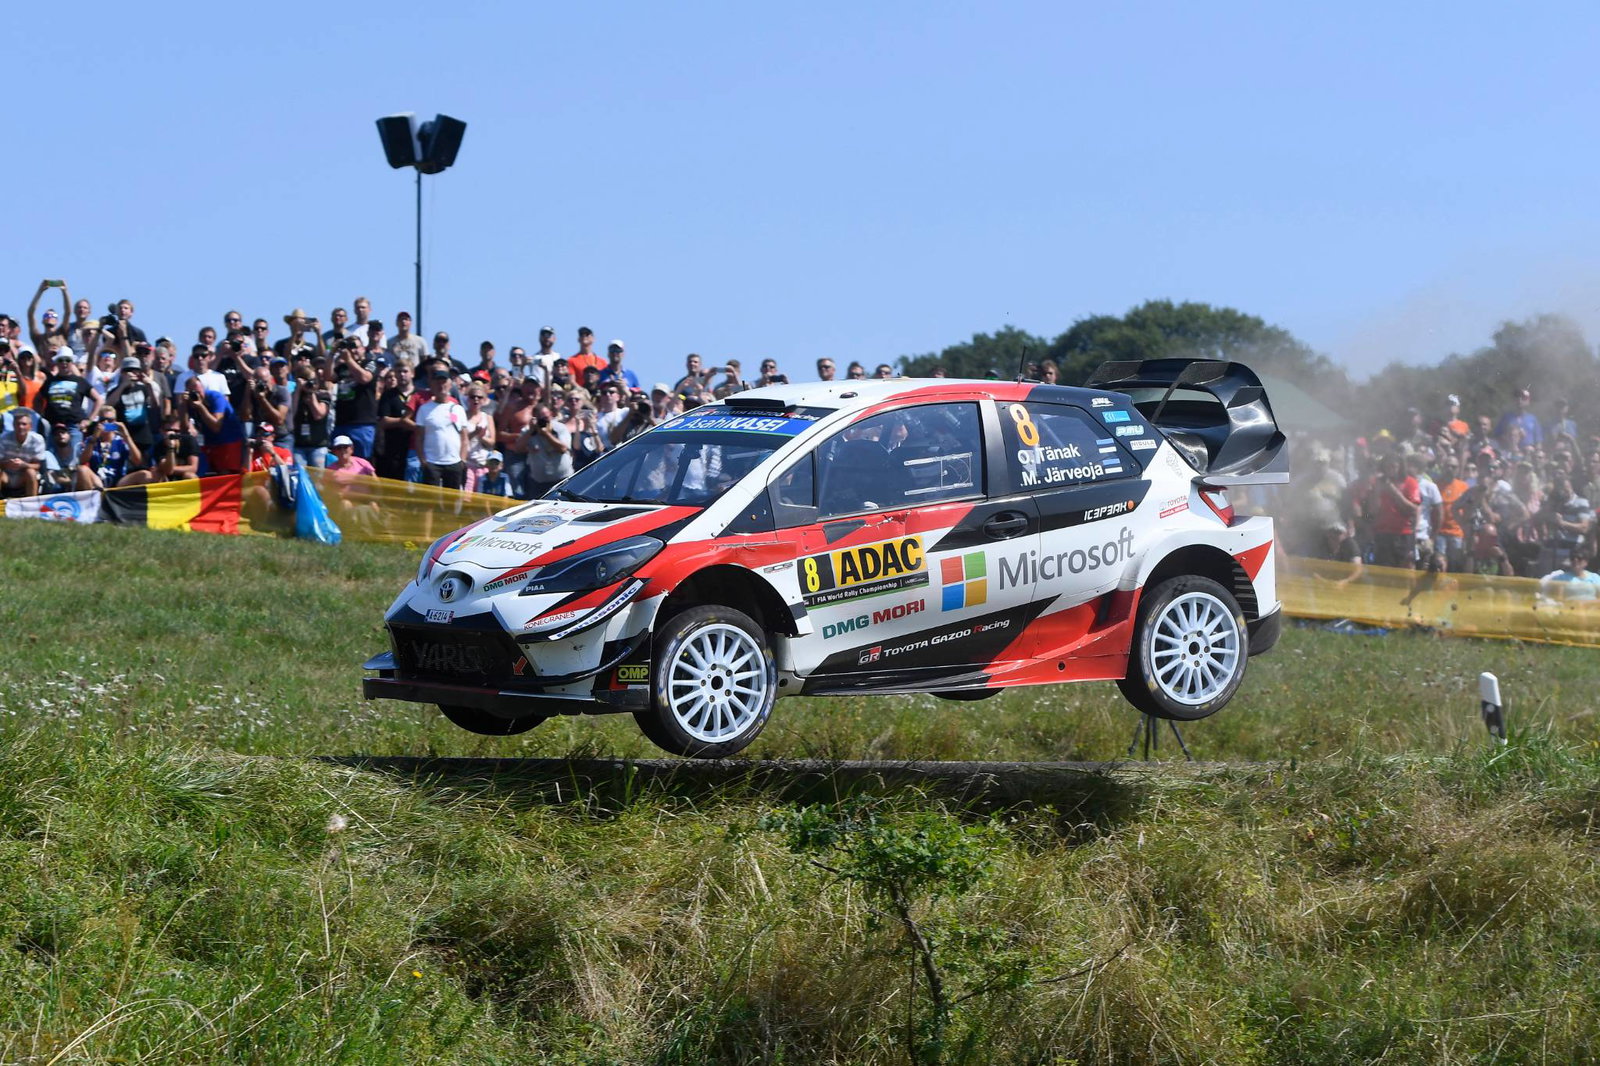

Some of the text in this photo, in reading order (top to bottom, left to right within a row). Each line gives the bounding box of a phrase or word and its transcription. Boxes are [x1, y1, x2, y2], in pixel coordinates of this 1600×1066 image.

[680, 417, 789, 432] AsahiKASEI
[1009, 403, 1040, 446] 8
[1036, 443, 1081, 463] Tänak
[1021, 462, 1104, 486] M. Järveoja
[471, 536, 544, 555] Microsoft
[803, 538, 922, 592] 8 ADAC
[998, 526, 1136, 590] Microsoft
[483, 573, 528, 592] DMG MORI
[525, 584, 545, 592] PIAA
[817, 595, 827, 603] FIA
[827, 592, 844, 602] World
[844, 589, 858, 598] Rally
[858, 582, 898, 594] Championship
[523, 611, 576, 631] KONECRANES
[823, 599, 925, 639] DMG MORI
[884, 640, 928, 657] TOYOTA
[931, 628, 971, 645] GAZOO
[973, 619, 1010, 634] Racing
[618, 667, 649, 679] OMP
